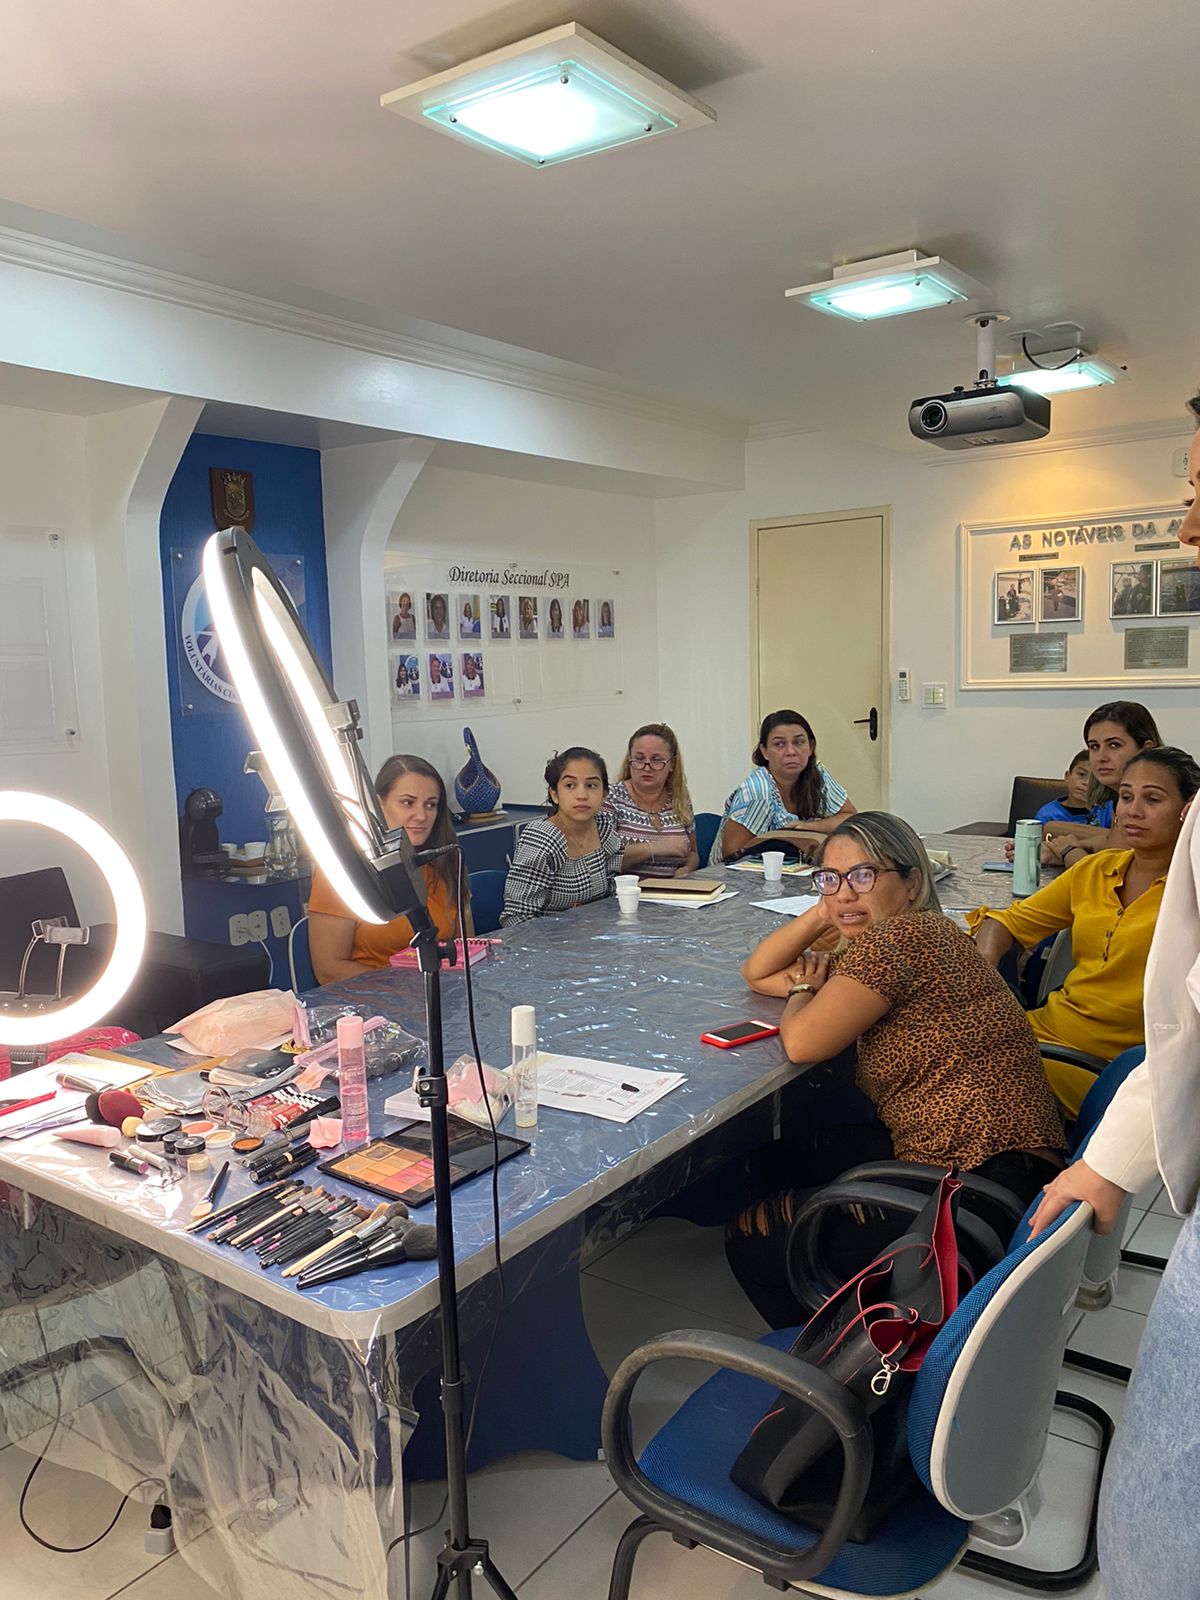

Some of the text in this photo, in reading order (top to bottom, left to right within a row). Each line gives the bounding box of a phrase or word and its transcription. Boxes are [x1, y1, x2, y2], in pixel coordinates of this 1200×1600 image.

[1010, 534, 1031, 550] AS
[1042, 525, 1124, 548] NOTÁVEIS
[1132, 521, 1157, 538] DA
[449, 566, 570, 589] Diretoria Seccional SPA
[185, 634, 222, 693] VOLUNTÁRIAS
